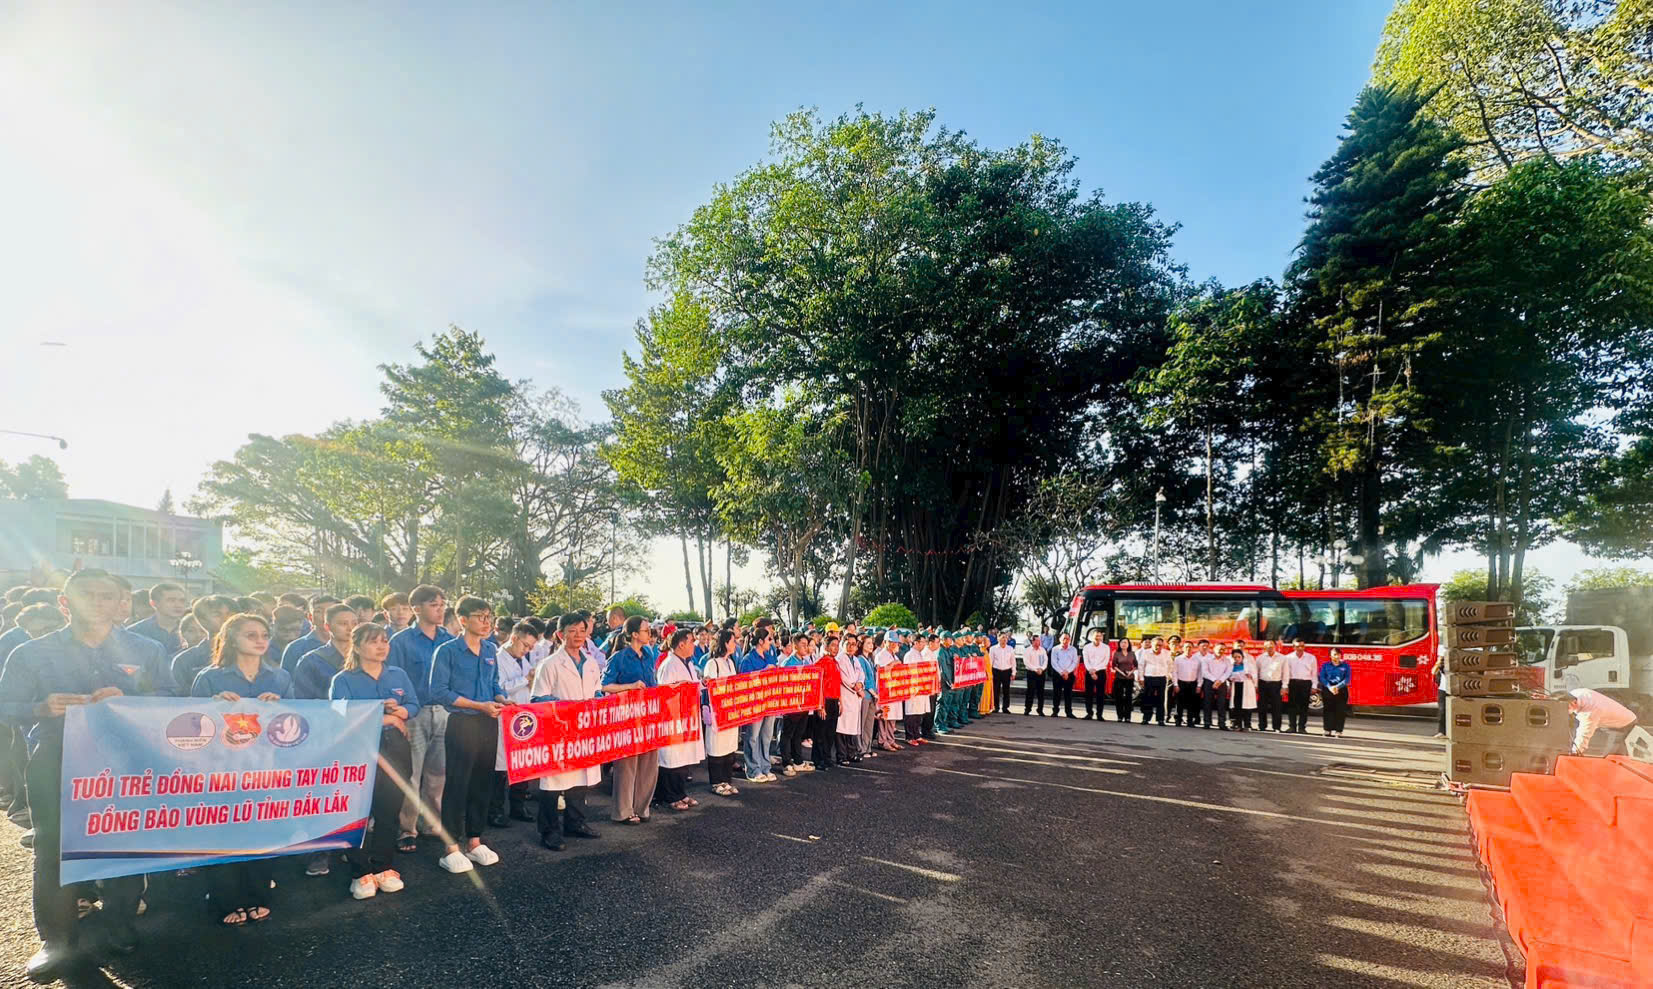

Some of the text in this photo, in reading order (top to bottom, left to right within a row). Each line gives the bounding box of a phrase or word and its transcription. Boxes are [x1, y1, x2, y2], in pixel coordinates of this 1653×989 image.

[72, 760, 367, 800] TUỔI TRẺ ĐỒNG NAI CHUNG TAY HỖ TRỢ
[86, 789, 349, 836] ĐỒNG BÀO VÙNG LŨ TỈNH ĐẮK LẮK
